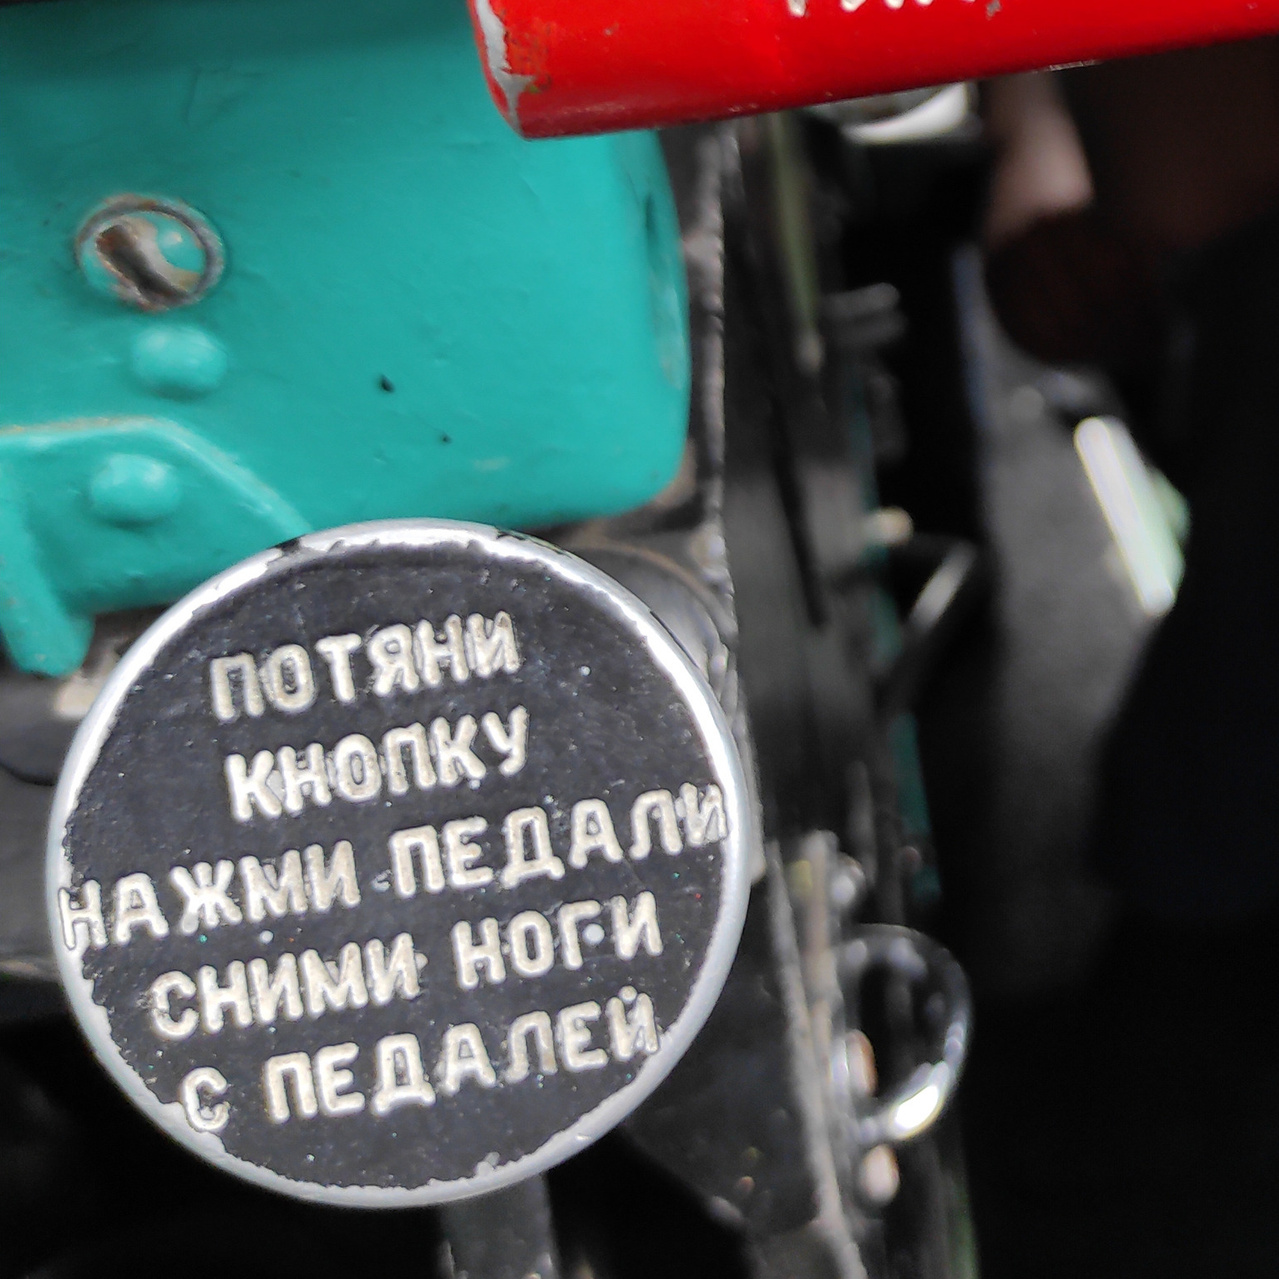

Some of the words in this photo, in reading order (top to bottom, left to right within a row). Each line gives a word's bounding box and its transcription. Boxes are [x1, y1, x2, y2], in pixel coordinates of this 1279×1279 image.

[209, 611, 520, 721] ПОТЯНИ
[224, 706, 530, 822] КНОПКУ
[57, 840, 362, 951] НАЖМИ
[388, 782, 731, 898] ПЕДАЛИ
[151, 932, 422, 1039] СНИМИ
[451, 891, 663, 990] НОГИ
[179, 1066, 230, 1132] С
[263, 986, 661, 1124] ПЕДАЛЕЙ
